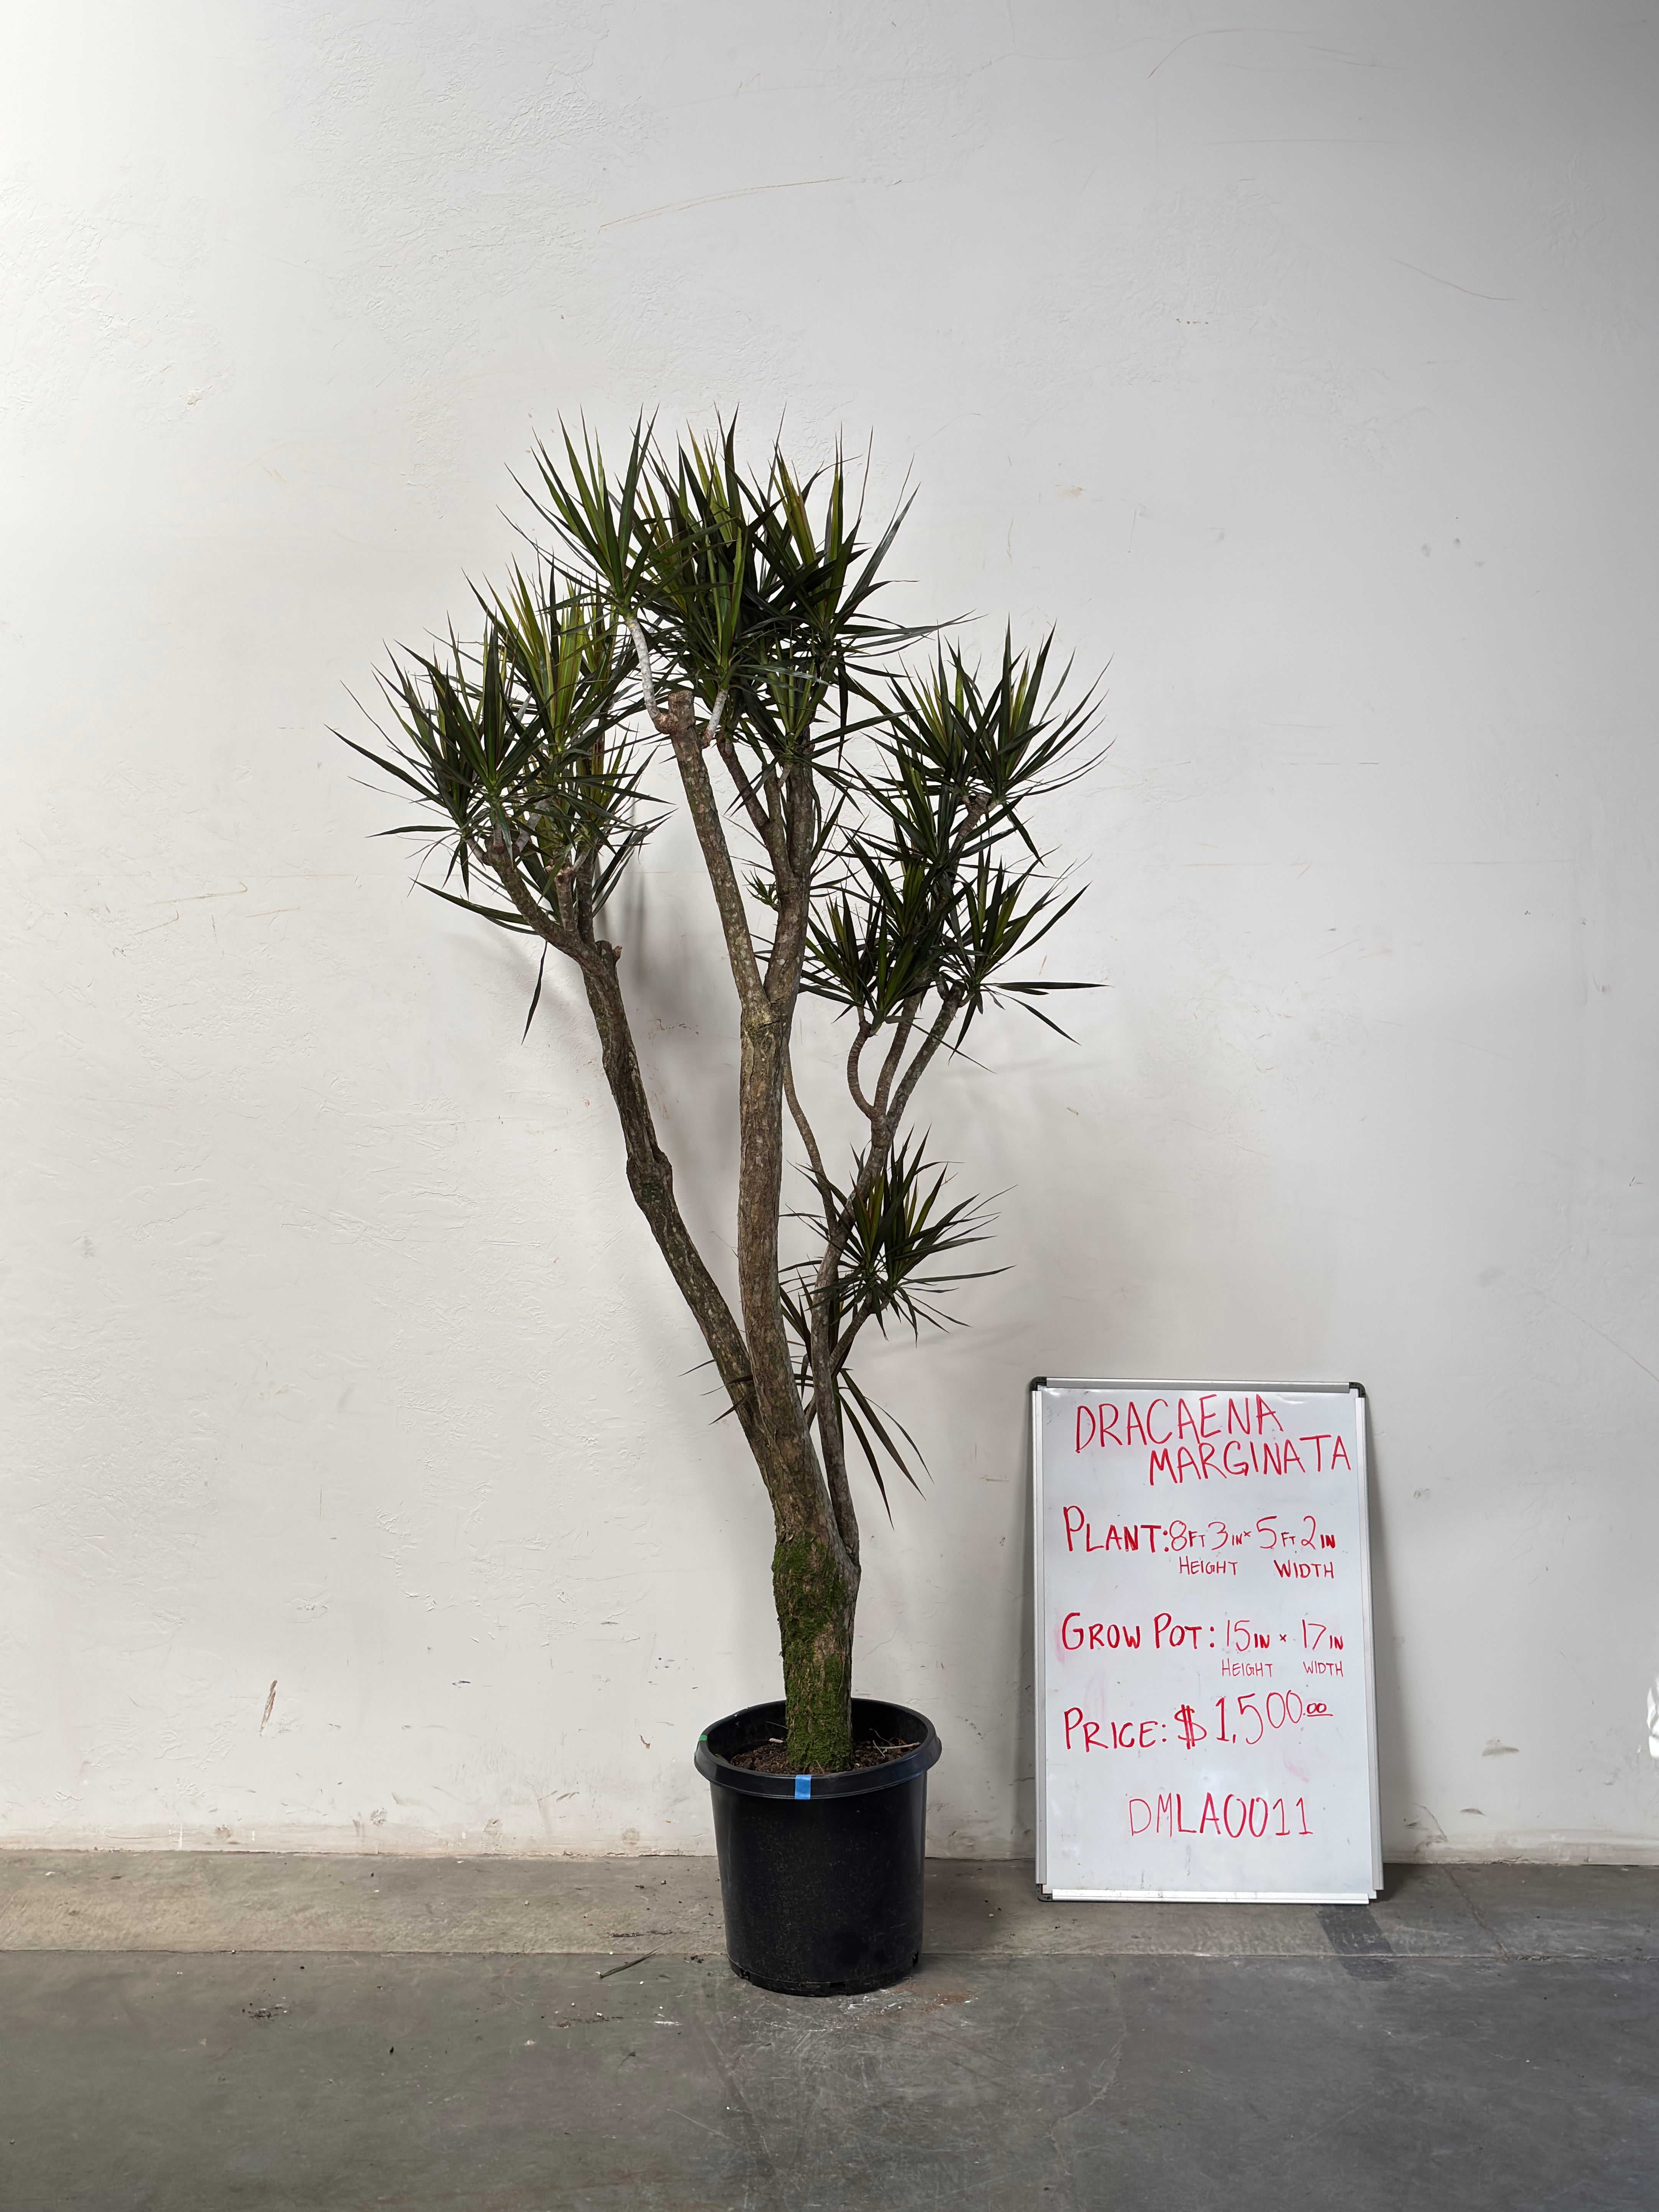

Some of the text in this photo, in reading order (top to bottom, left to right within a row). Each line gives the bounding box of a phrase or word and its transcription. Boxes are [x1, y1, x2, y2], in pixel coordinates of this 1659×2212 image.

[1074, 1394, 1283, 1453] DRACAENA
[1149, 1434, 1351, 1486] MARGINATA
[1063, 1505, 1168, 1553] PLANT:
[1179, 1556, 1334, 1579] HEIGHT WIDTH
[1061, 1612, 1141, 1650] GROW
[1153, 1612, 1215, 1649] POT:
[1222, 1658, 1344, 1677] HEIGHT WIDTH
[1064, 1707, 1166, 1753] PRICE:
[1129, 1792, 1313, 1838] DMLA0011
